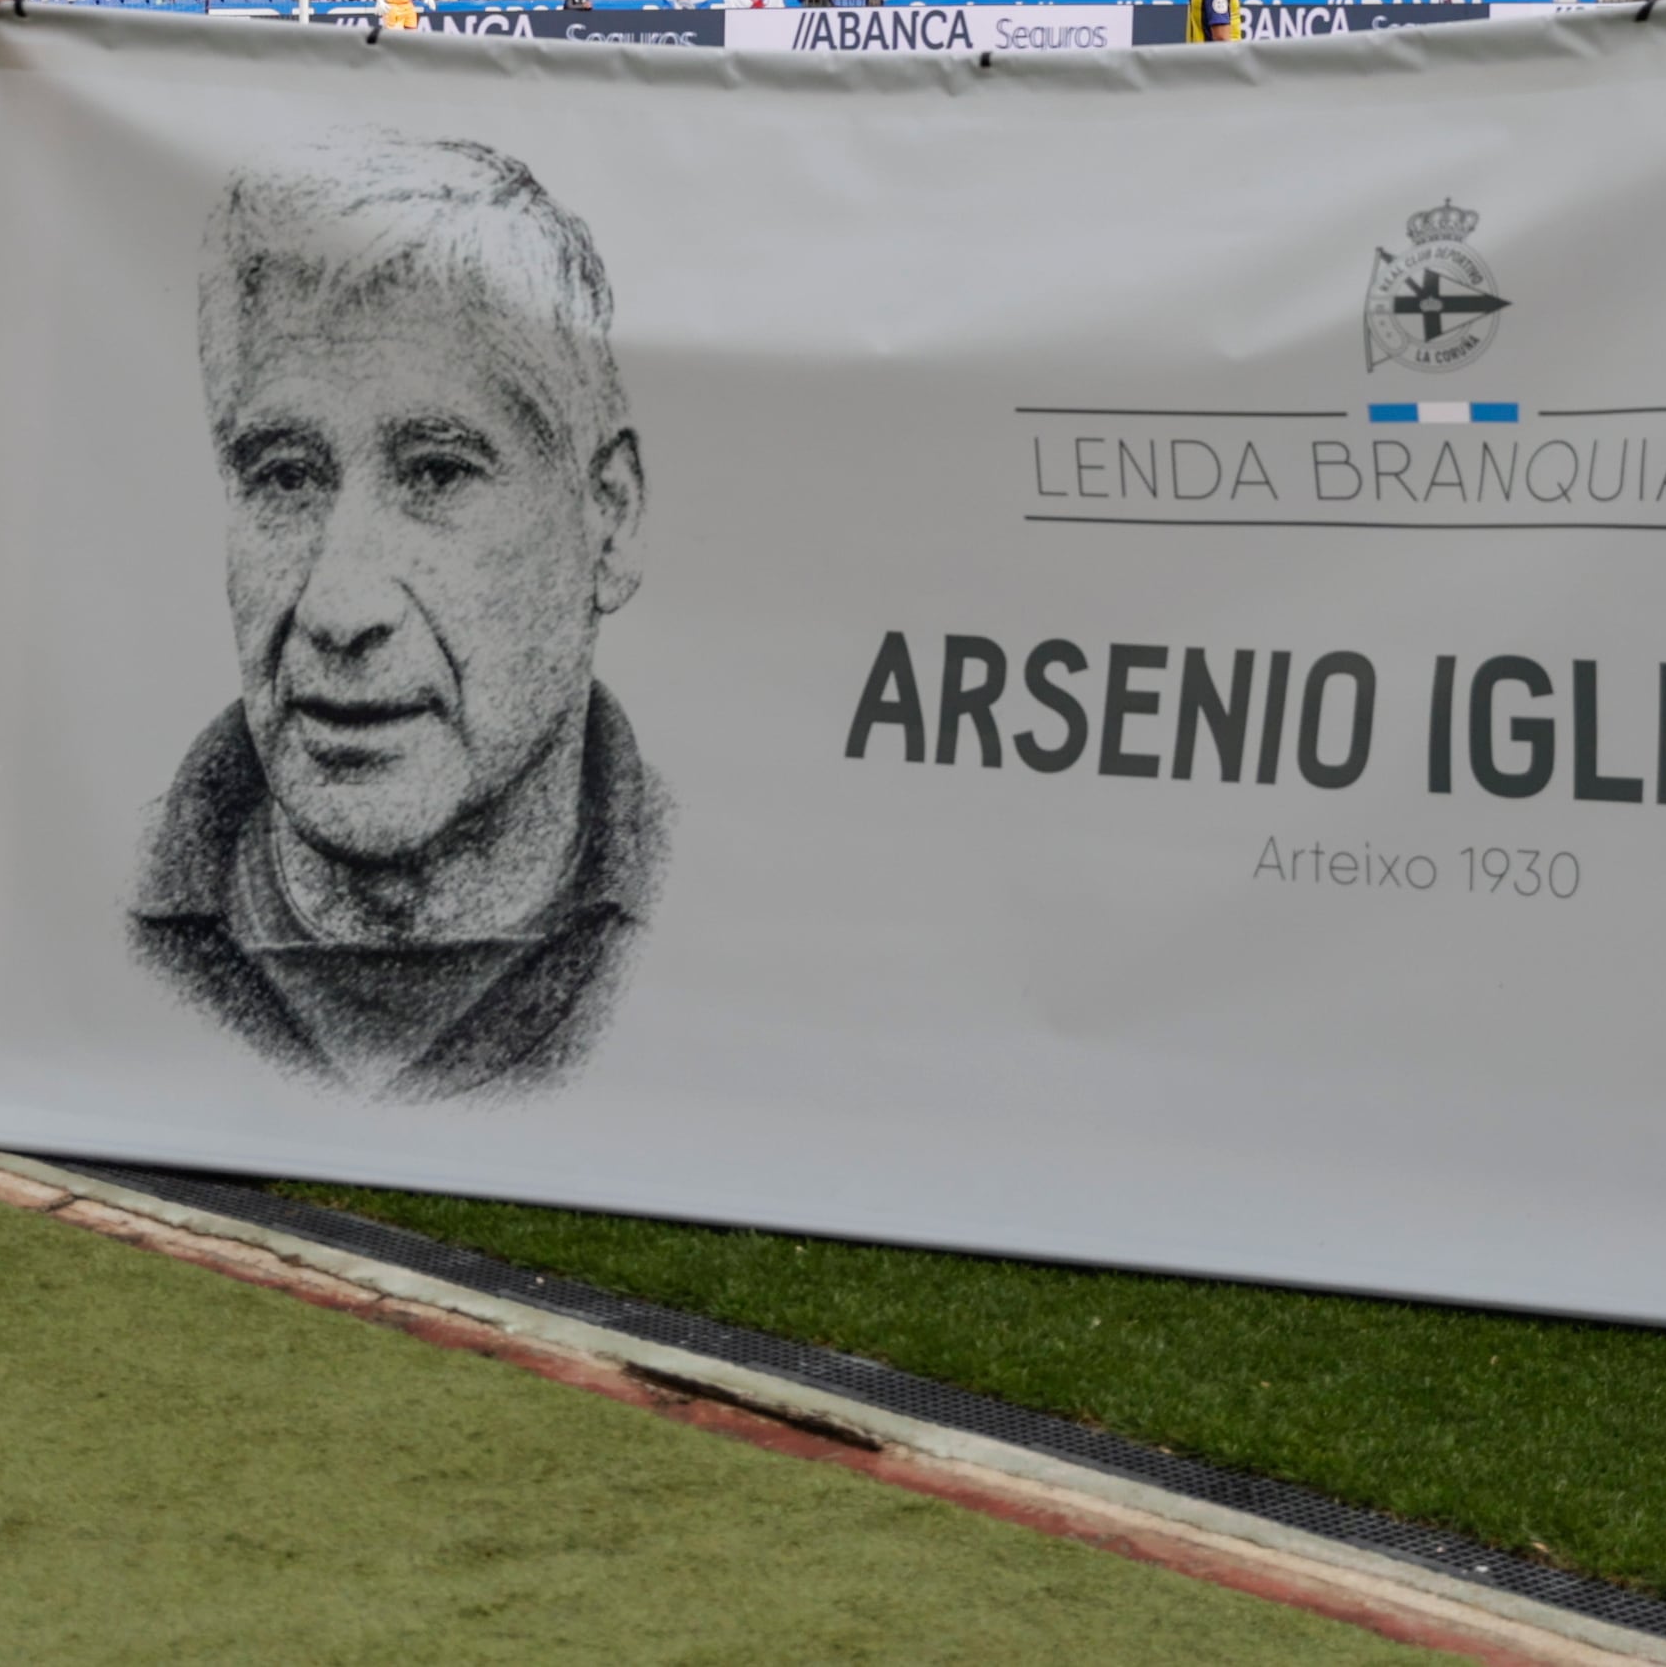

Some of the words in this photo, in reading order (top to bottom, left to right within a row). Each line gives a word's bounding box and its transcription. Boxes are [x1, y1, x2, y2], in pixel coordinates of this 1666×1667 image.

[1380, 266, 1404, 292] REAL
[1405, 249, 1432, 267] CLUB
[1435, 247, 1484, 285] DEPORTIVO
[1416, 350, 1430, 363] LA
[1435, 334, 1480, 364] CORUÑA
[1035, 436, 1278, 501] LENDA
[844, 630, 1377, 790] ARSENIO
[1254, 835, 1437, 892] Arteixo
[1460, 847, 1581, 900] 1930
